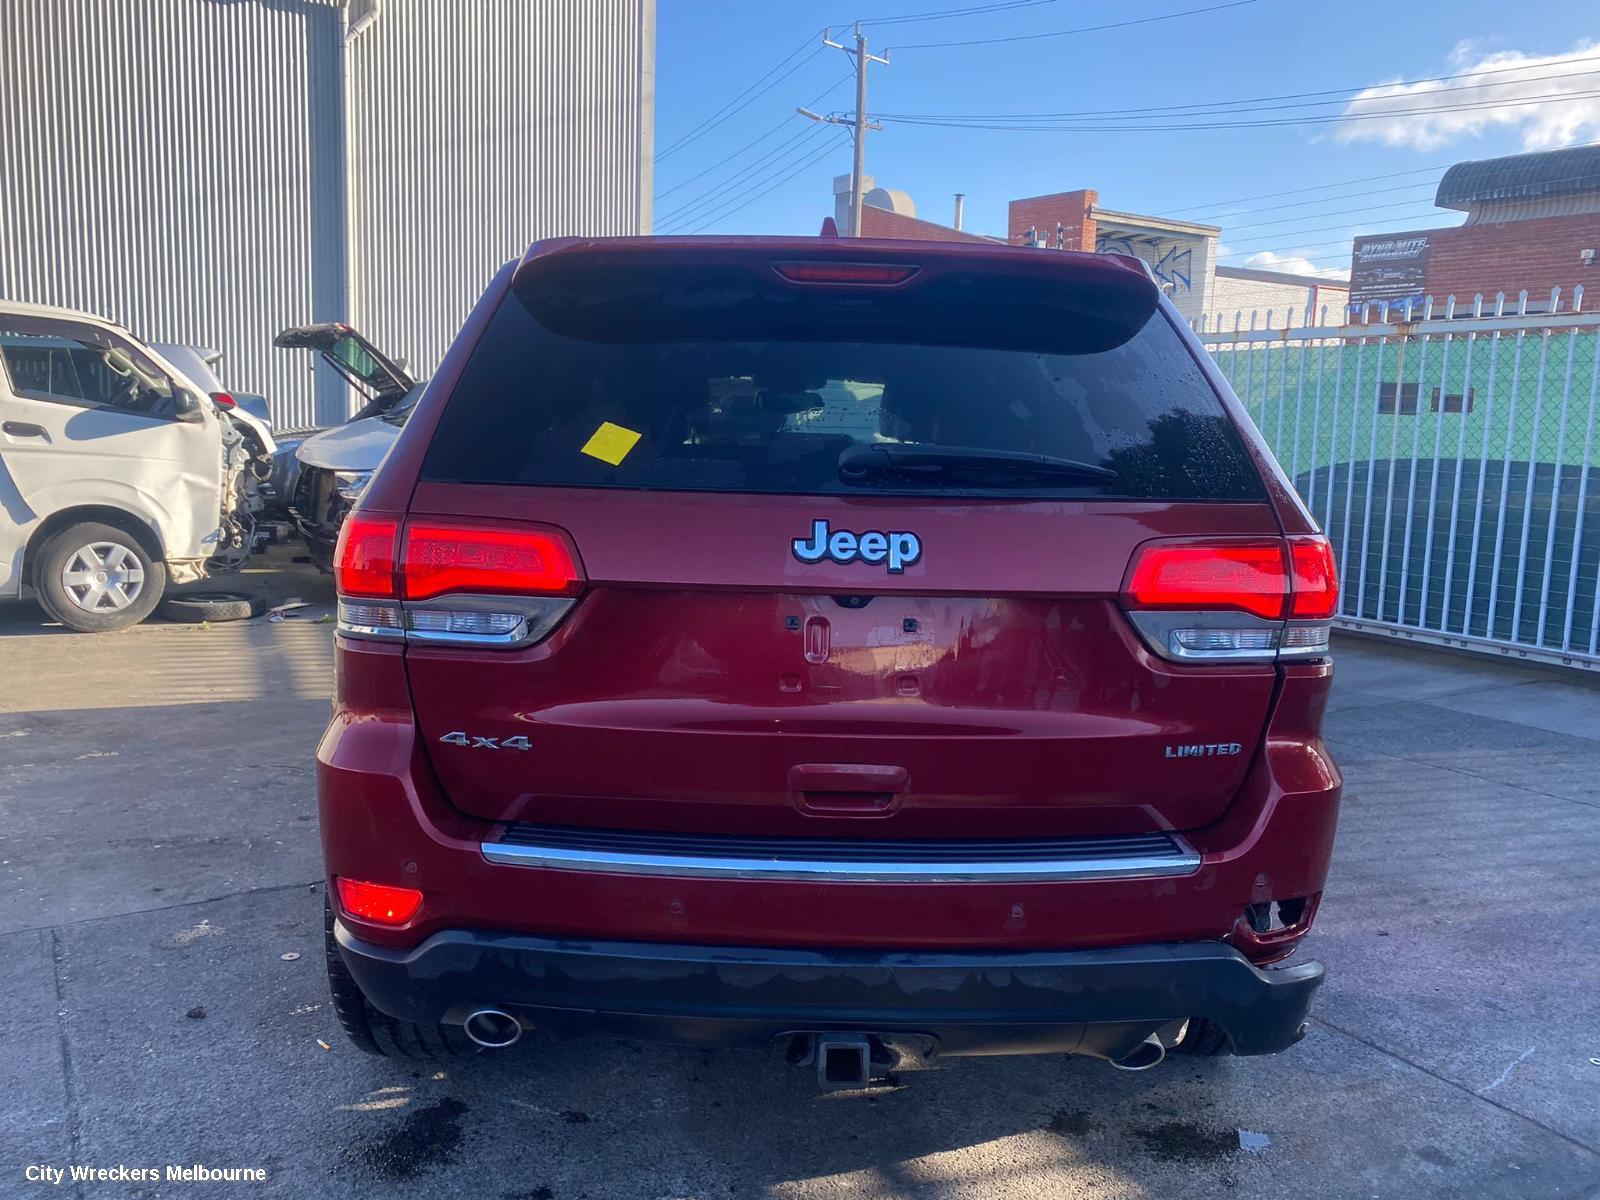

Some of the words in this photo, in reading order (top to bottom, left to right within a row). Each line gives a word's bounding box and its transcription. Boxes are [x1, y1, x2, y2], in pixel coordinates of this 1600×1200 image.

[792, 519, 921, 574] Jeep
[439, 731, 532, 750] 4x4
[1165, 743, 1242, 758] LIMITED
